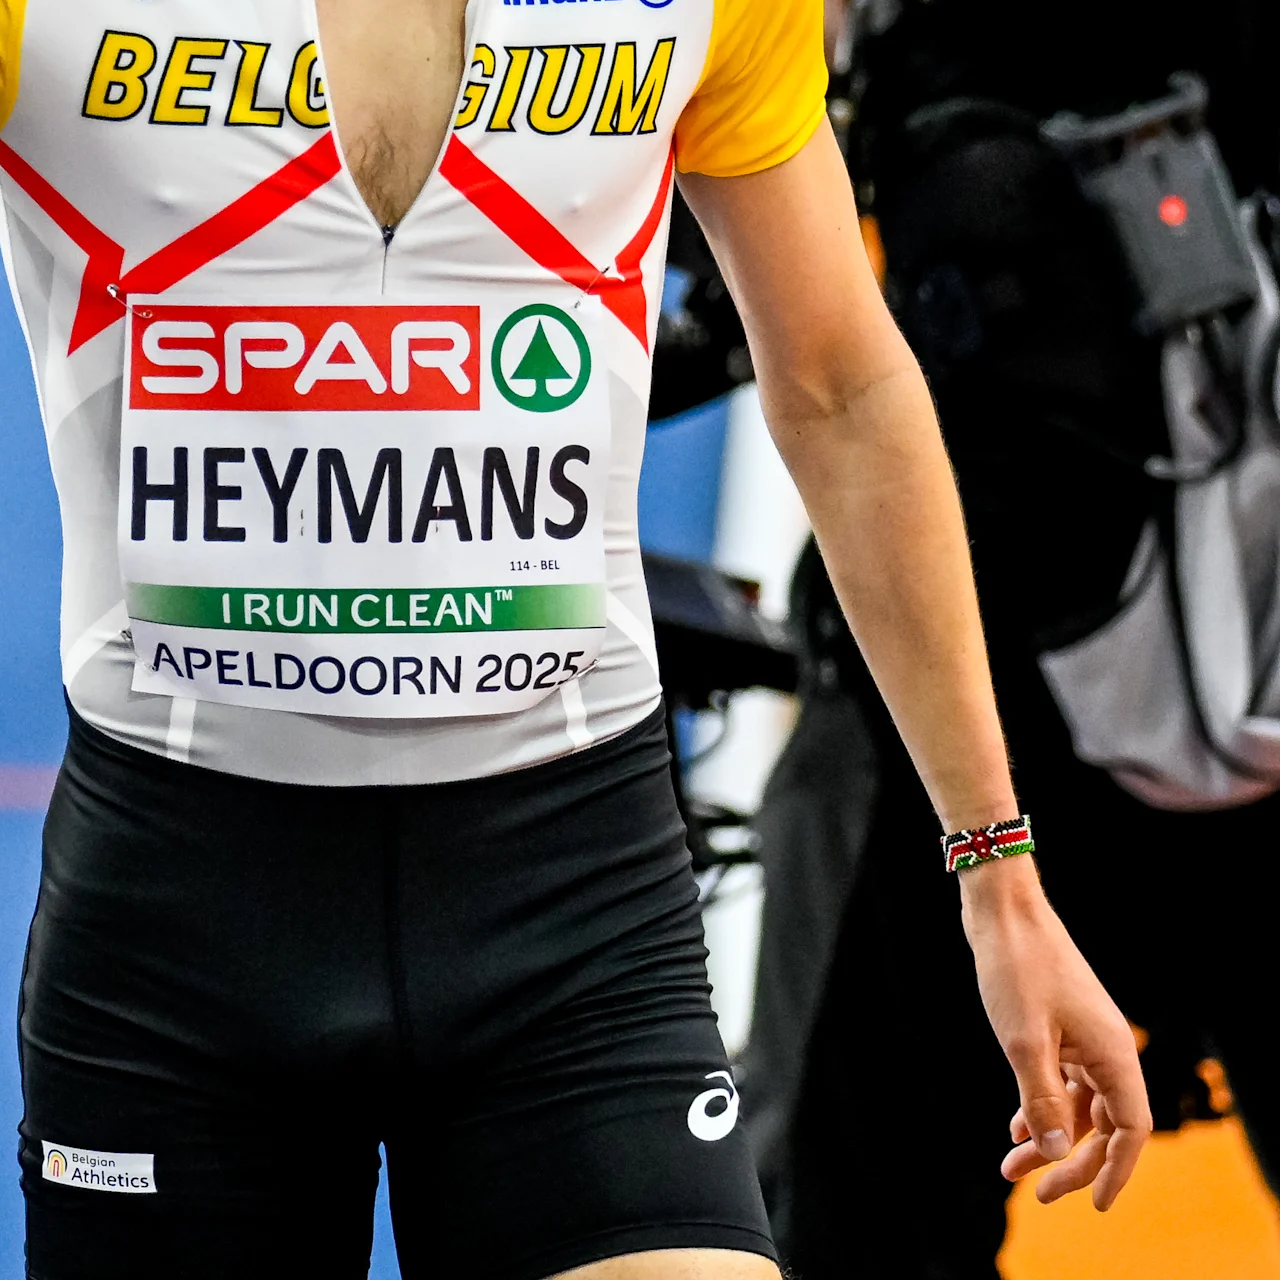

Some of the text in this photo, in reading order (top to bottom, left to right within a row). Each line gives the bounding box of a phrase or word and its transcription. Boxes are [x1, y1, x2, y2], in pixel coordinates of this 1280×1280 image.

[141, 320, 471, 395] SPAR
[130, 444, 591, 543] HEYMANS
[509, 560, 531, 572] 114
[540, 559, 561, 570] BEL
[221, 592, 231, 624] I
[243, 593, 340, 626] RUN
[152, 641, 585, 697] APELDOORN 2025
[71, 1153, 116, 1168] Belgian
[71, 1167, 149, 1188] Athletics
